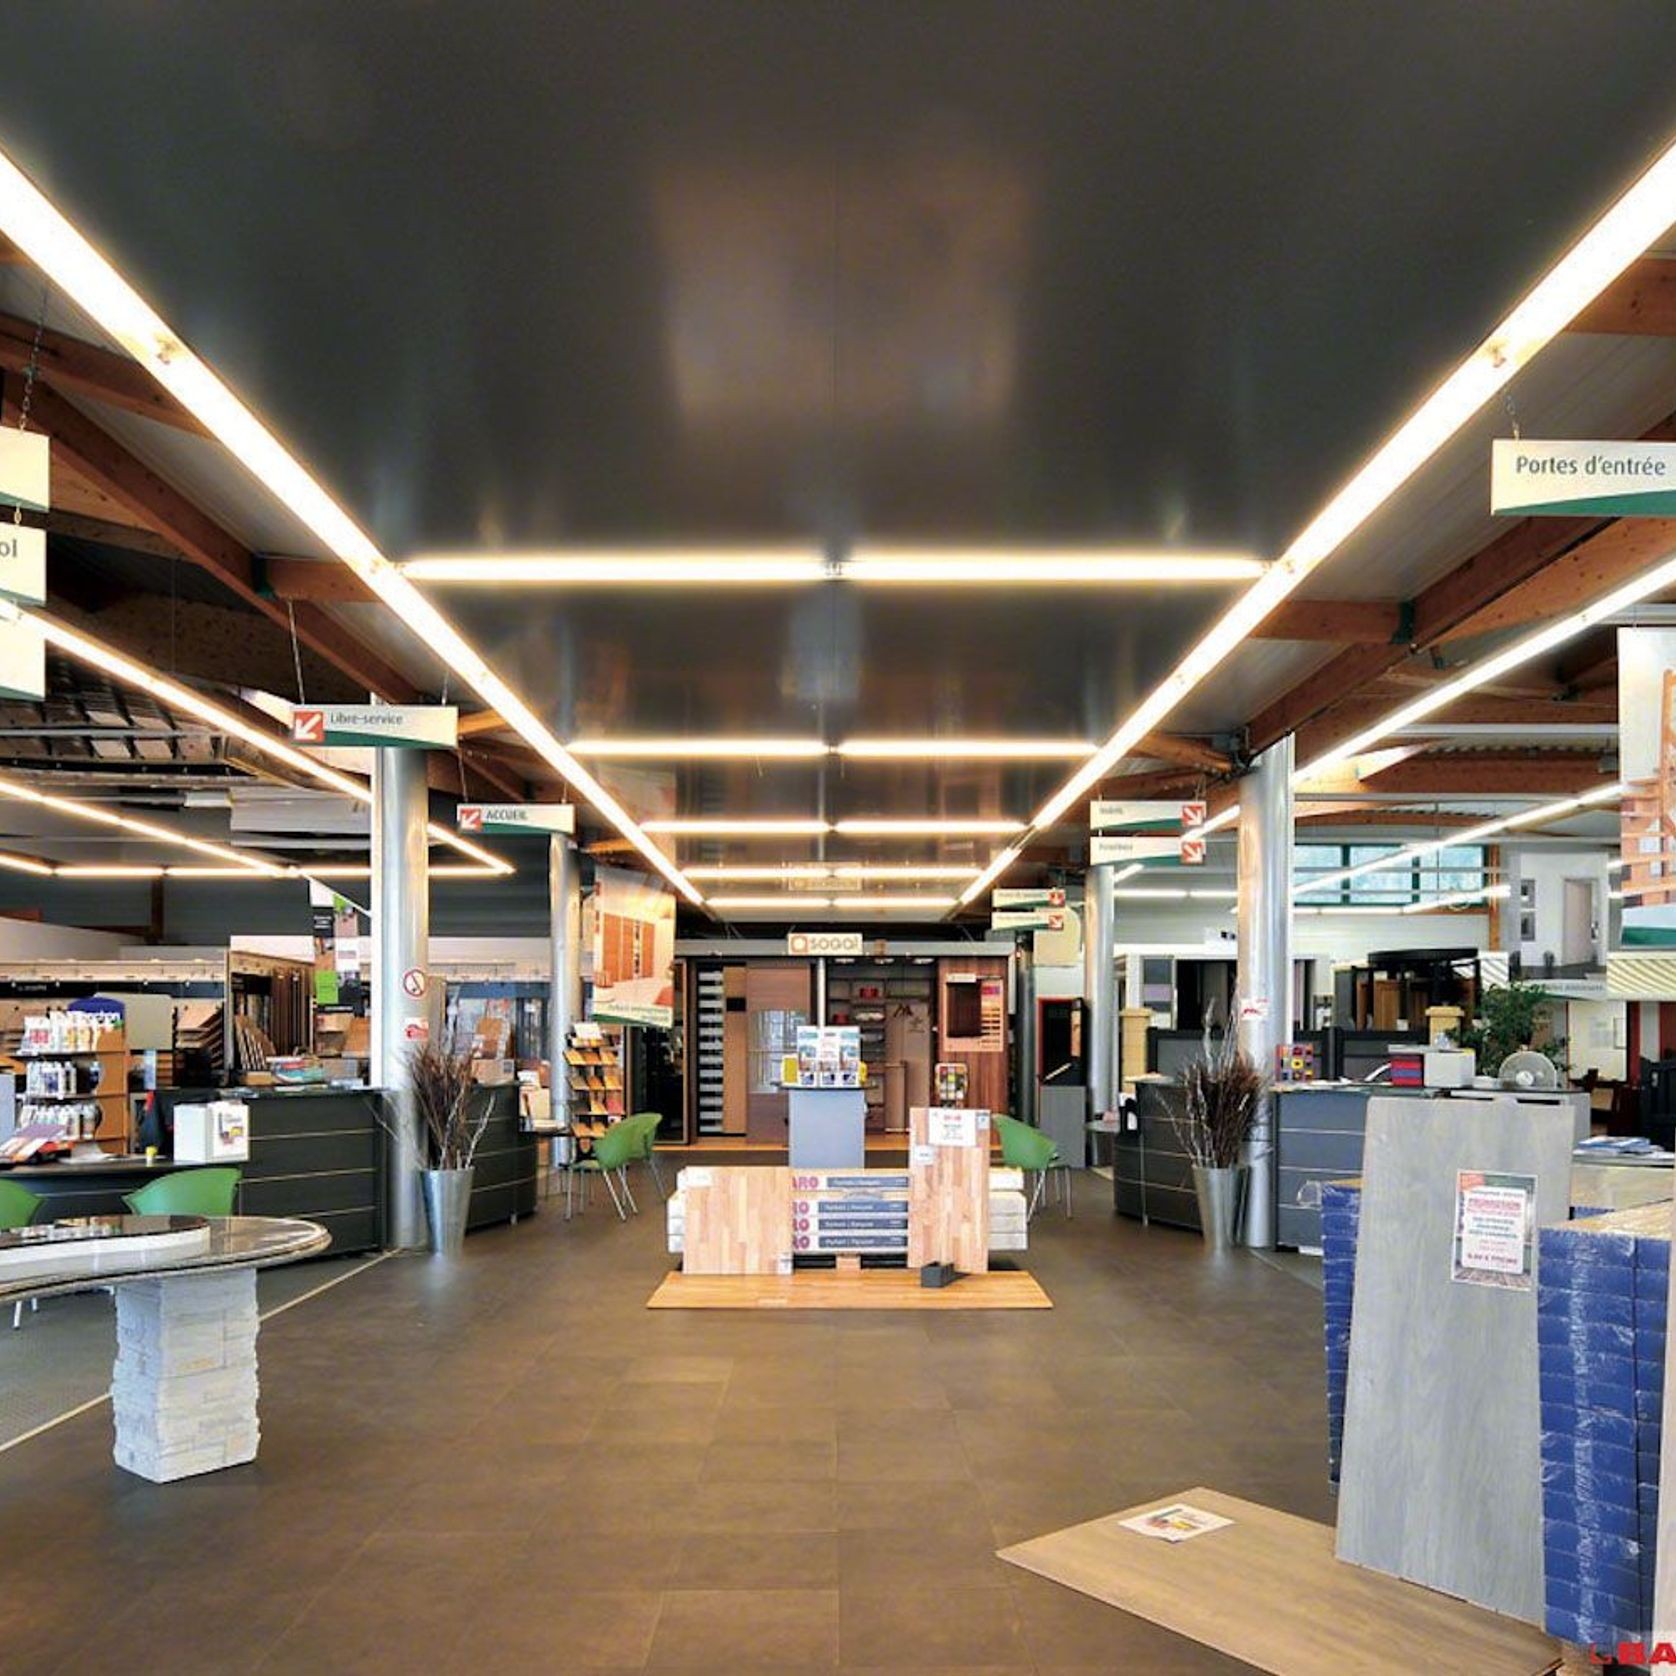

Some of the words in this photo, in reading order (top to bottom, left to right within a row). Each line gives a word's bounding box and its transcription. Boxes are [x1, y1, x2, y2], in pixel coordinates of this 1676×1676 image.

[1516, 456, 1579, 474] Portes
[1585, 455, 1666, 475] d'entrée
[330, 712, 404, 725] Libre-service
[486, 809, 528, 820] ACCUEIL
